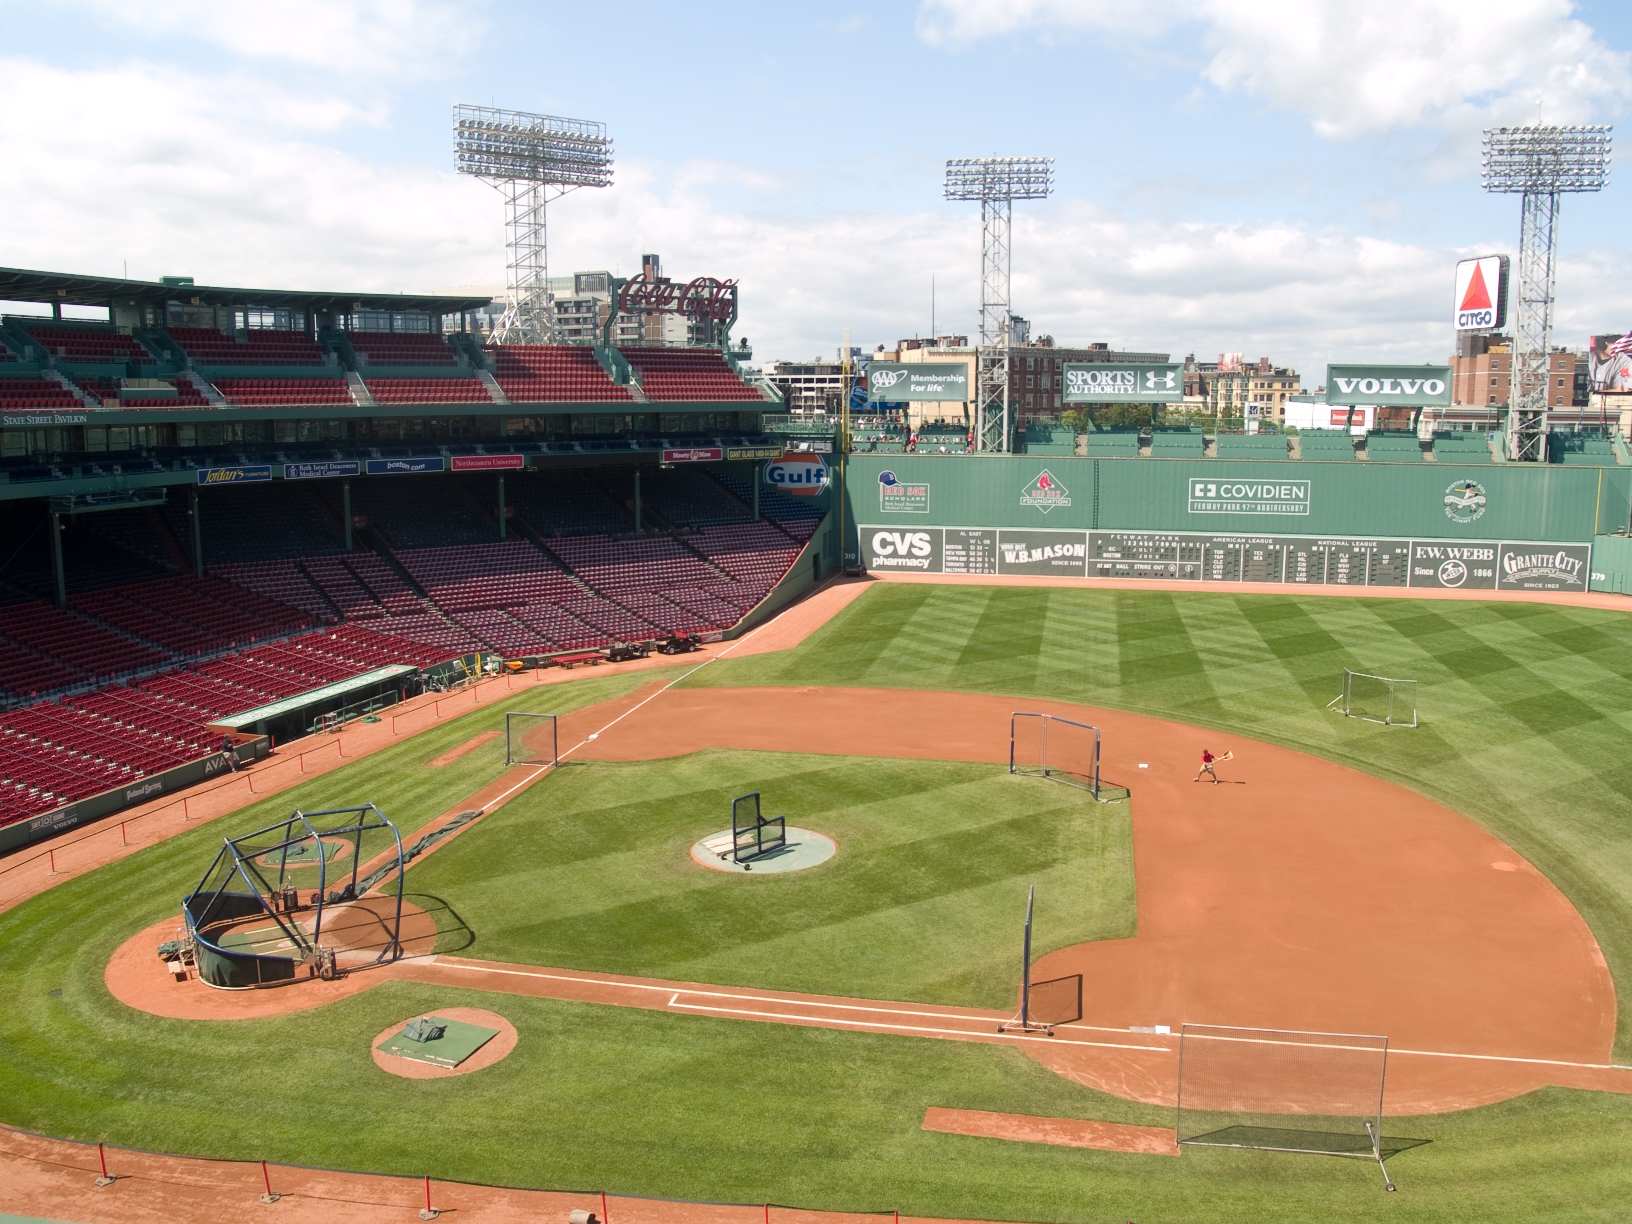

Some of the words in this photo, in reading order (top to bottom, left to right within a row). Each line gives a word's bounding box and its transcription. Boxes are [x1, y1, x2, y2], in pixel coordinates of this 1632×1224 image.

[618, 273, 739, 318] Coca-Cola
[1459, 311, 1492, 326] CITGO
[873, 370, 896, 387] AAA
[1067, 370, 1134, 385] SPORTS
[1067, 385, 1134, 394] AUTHORITY
[1333, 378, 1445, 395] VOLVO
[4, 416, 26, 425] STATE
[27, 416, 52, 424] STREET
[54, 415, 87, 423] PAVILION
[204, 468, 244, 484] Jordan's
[768, 466, 824, 483] Gulf
[885, 487, 904, 496] RED
[907, 487, 926, 496] SOX
[1220, 484, 1304, 498] COVIDIEN
[1445, 480, 1464, 493] BOSTON
[1477, 484, 1486, 494] SOX
[872, 532, 931, 556] CVS
[1446, 548, 1494, 560] WEBB
[872, 556, 930, 569] pharmacy
[1414, 567, 1434, 575] Since
[1473, 569, 1492, 577] 1866
[205, 752, 240, 773] AVAA
[53, 818, 78, 829] VOLVO
